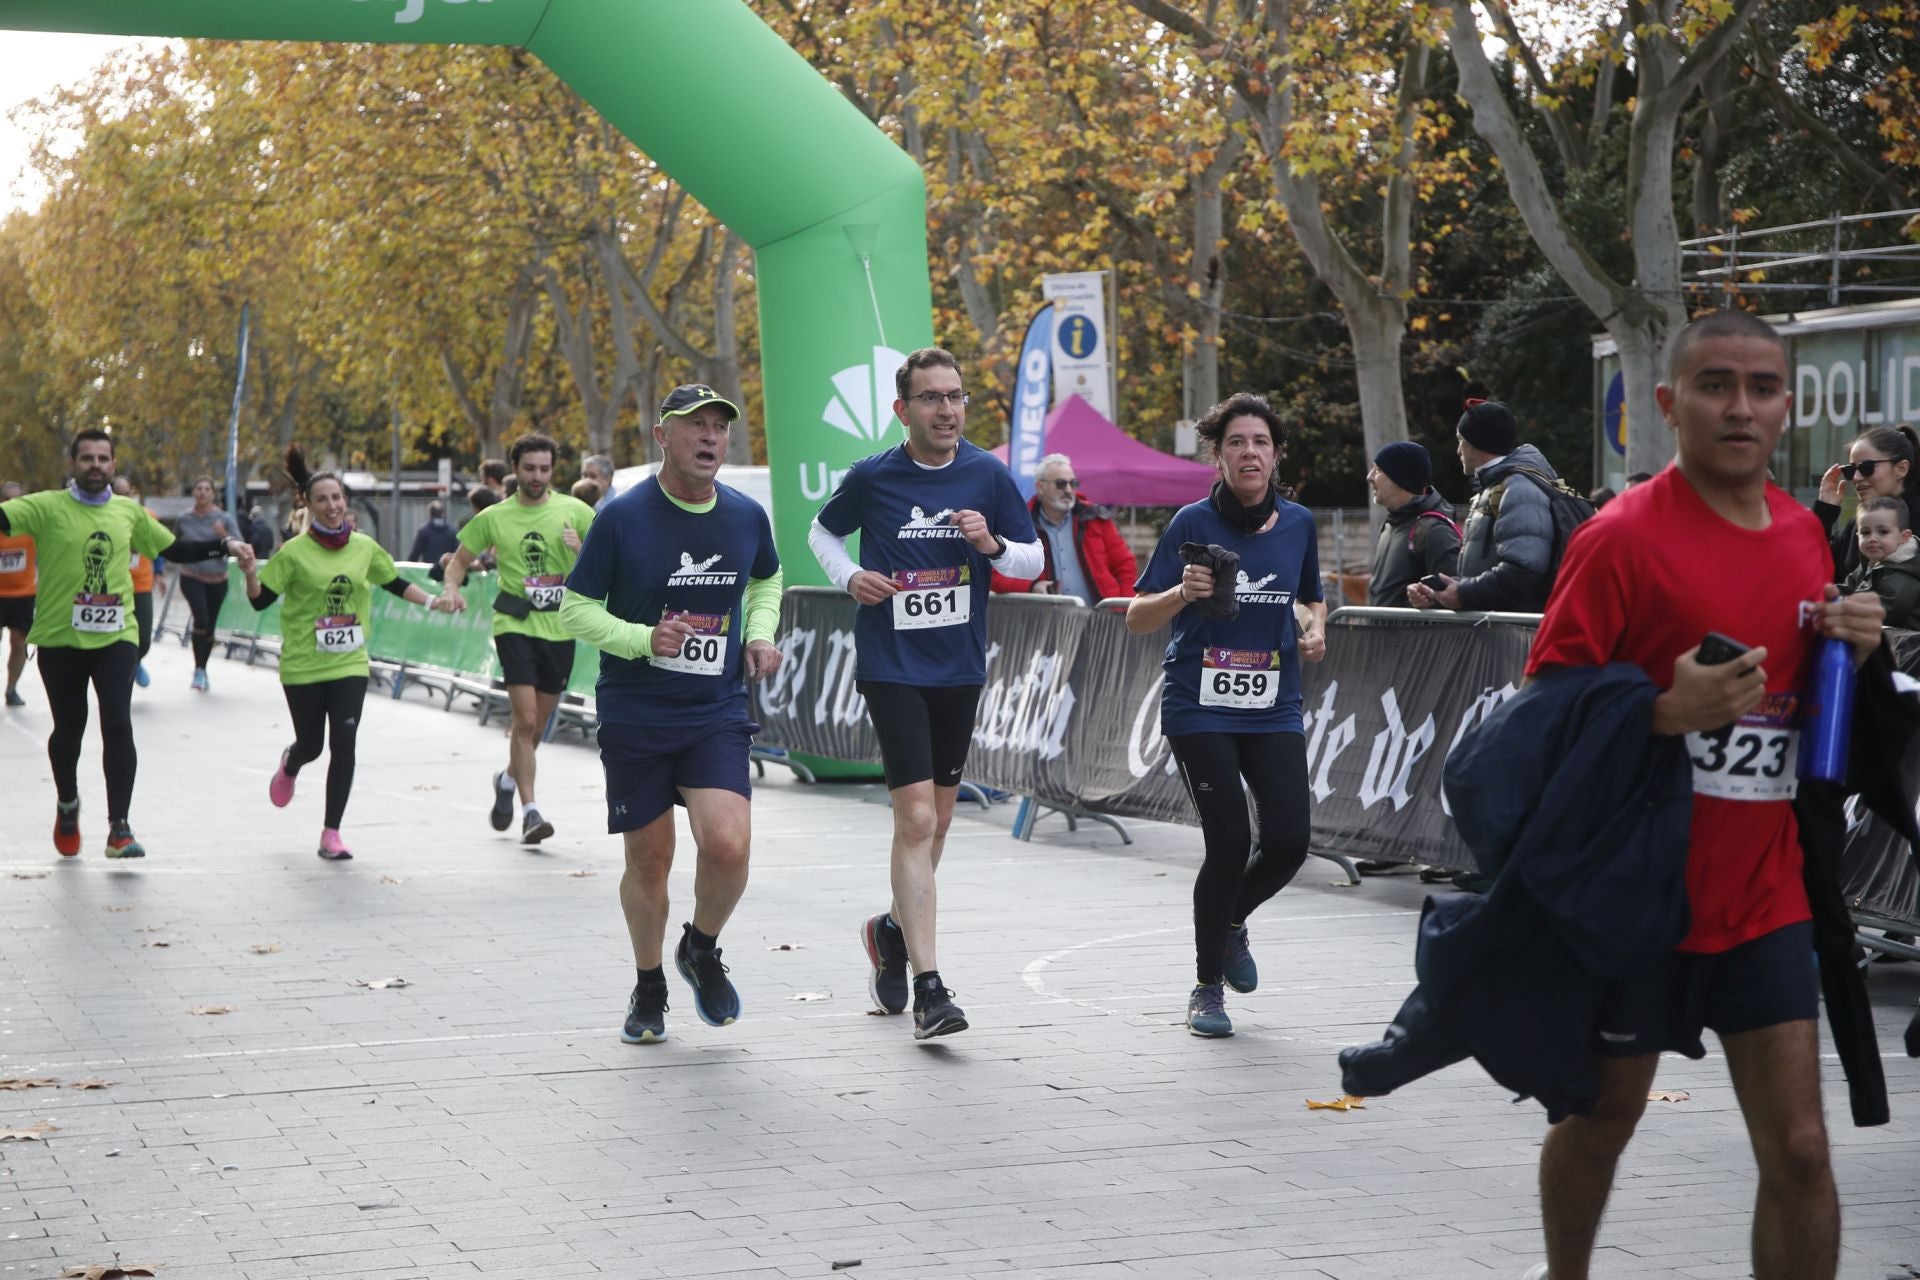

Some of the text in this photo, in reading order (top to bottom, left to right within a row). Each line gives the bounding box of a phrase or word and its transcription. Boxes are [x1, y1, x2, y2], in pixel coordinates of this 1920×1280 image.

[1786, 356, 1920, 427] DOLID
[1020, 348, 1047, 476] IVECO
[667, 576, 737, 587] MICHELIN
[533, 588, 563, 602] 620
[904, 589, 956, 616] 661
[1234, 594, 1290, 604] ICHELIN
[81, 608, 116, 623] 622
[324, 628, 354, 646] 621
[668, 637, 718, 662] 60
[1213, 672, 1267, 696] 659
[1357, 687, 1436, 811] de
[1692, 732, 1790, 777] 323
